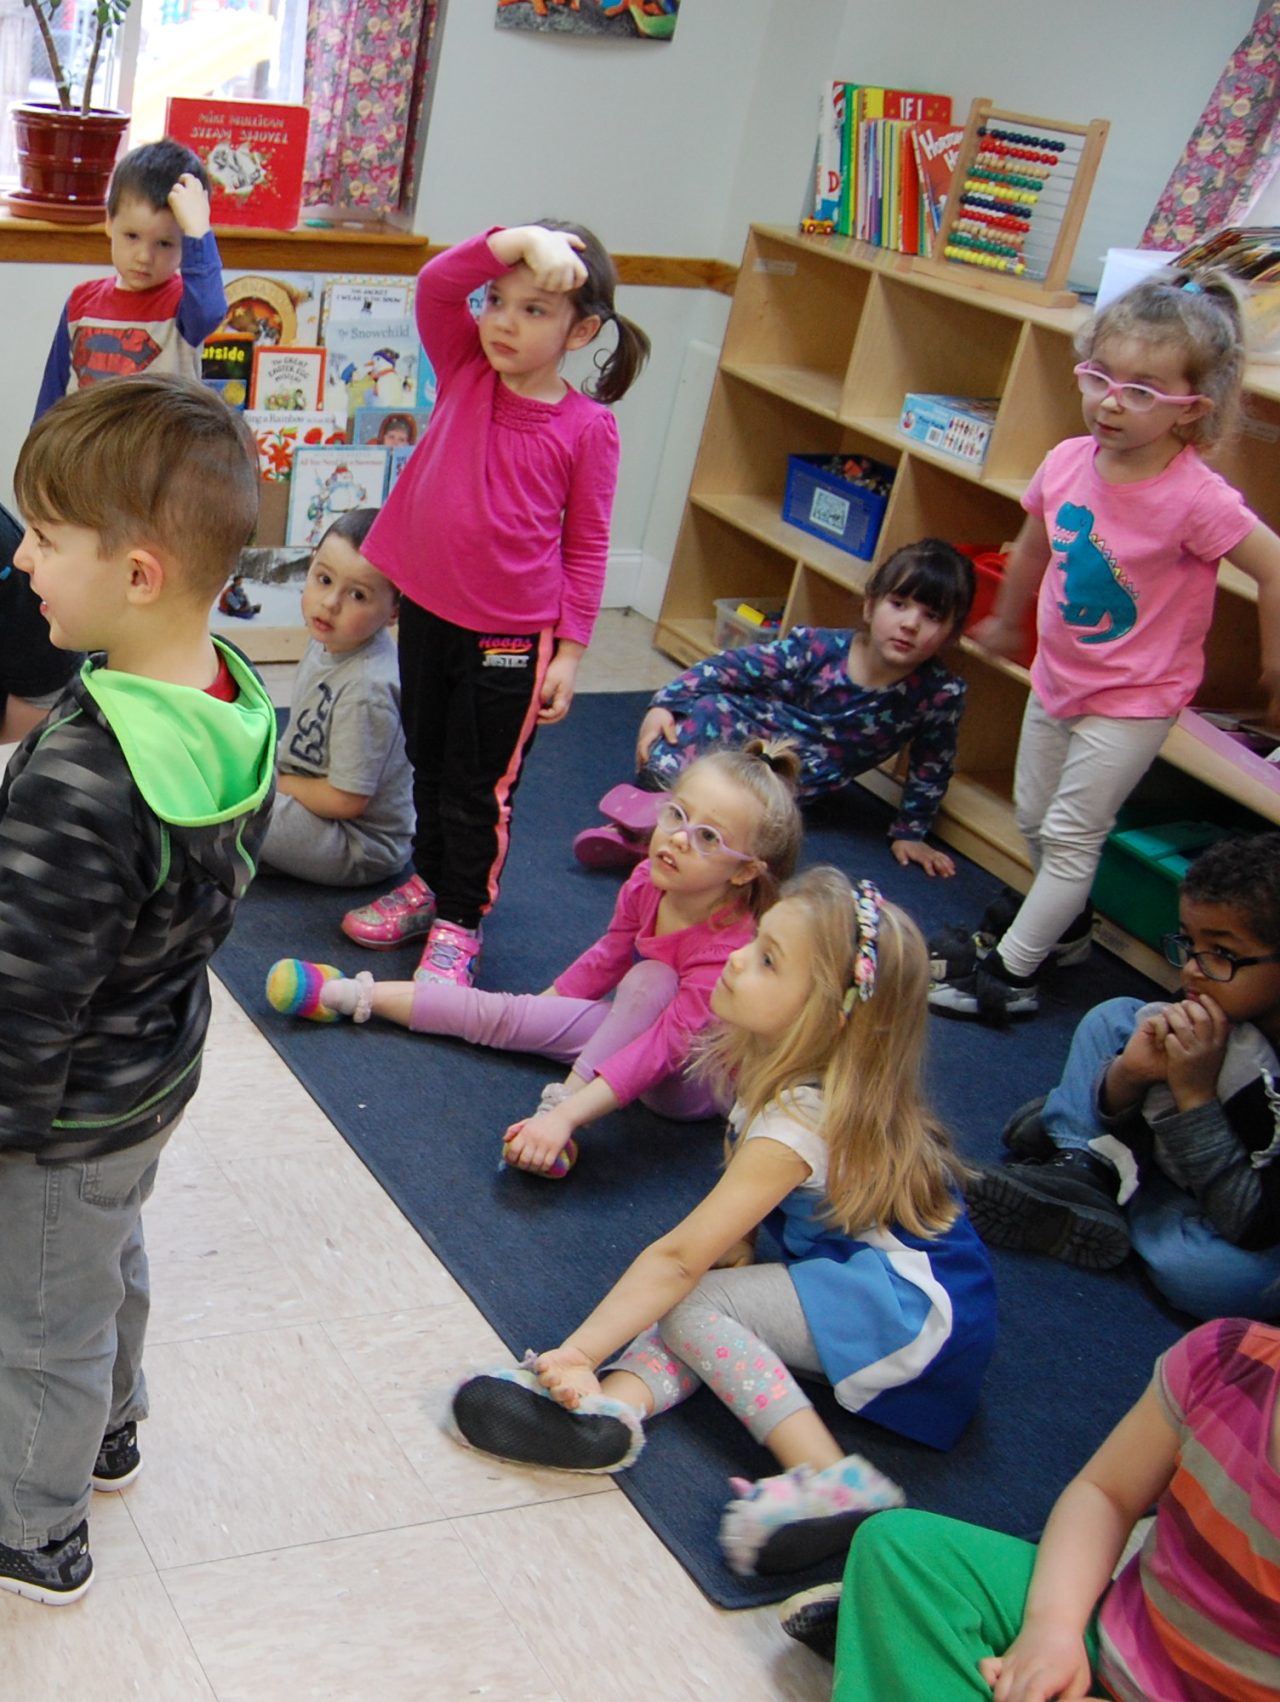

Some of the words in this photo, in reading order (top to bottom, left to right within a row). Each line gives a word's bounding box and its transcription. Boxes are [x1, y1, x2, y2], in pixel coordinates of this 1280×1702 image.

[900, 97, 915, 119] IF
[190, 127, 232, 139] STEAM
[239, 129, 289, 144] SHOVEL
[351, 323, 410, 339] Snowchild
[201, 346, 244, 361] utside
